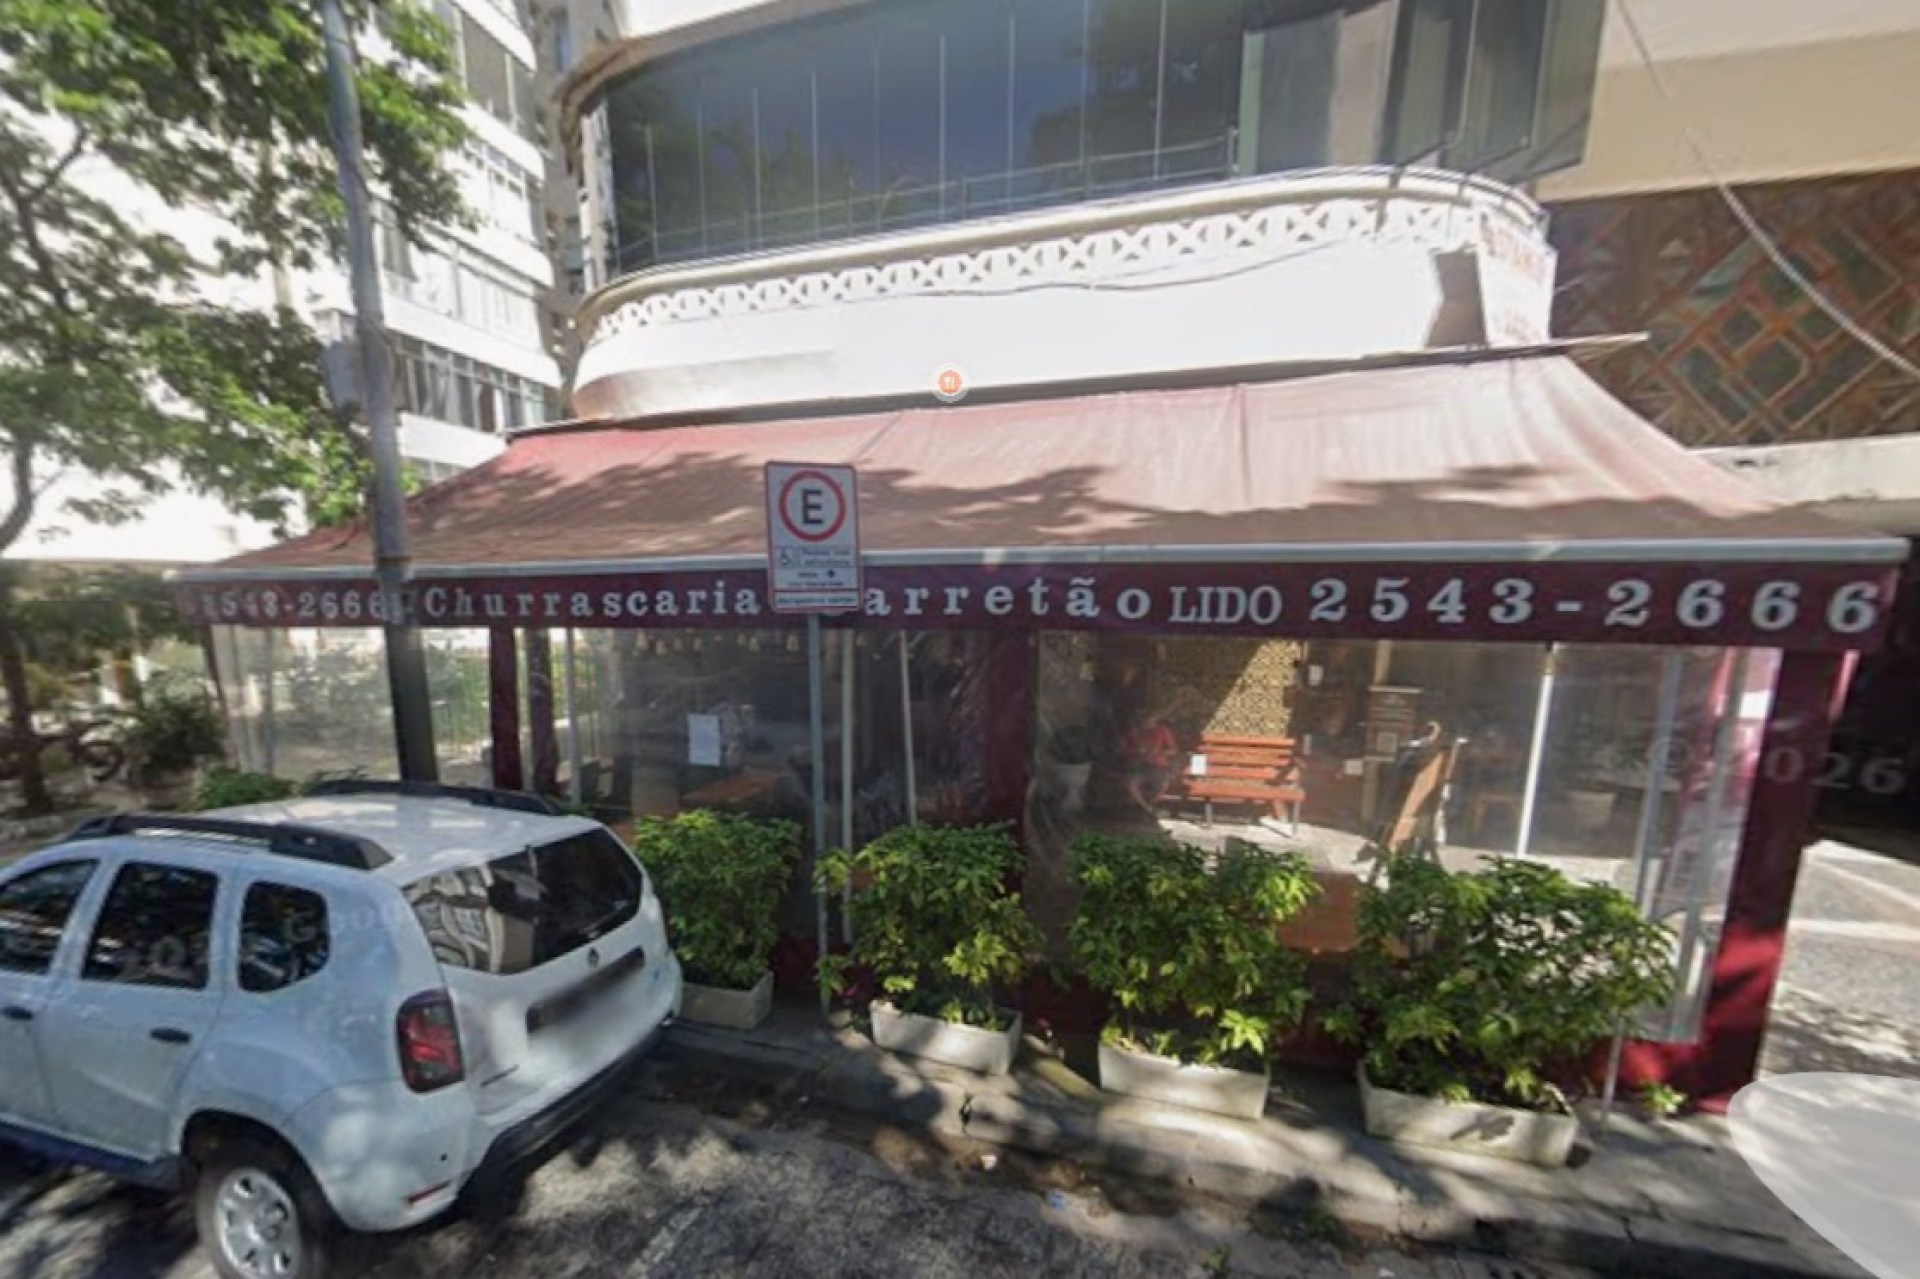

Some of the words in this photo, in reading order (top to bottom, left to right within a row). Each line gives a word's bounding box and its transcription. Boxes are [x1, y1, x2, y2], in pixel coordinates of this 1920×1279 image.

[802, 488, 824, 524] E
[424, 579, 762, 619] Churrascaria
[818, 576, 1151, 619] arretão
[1169, 585, 1283, 625] LIDO
[1309, 577, 1879, 633] 2543-2666
